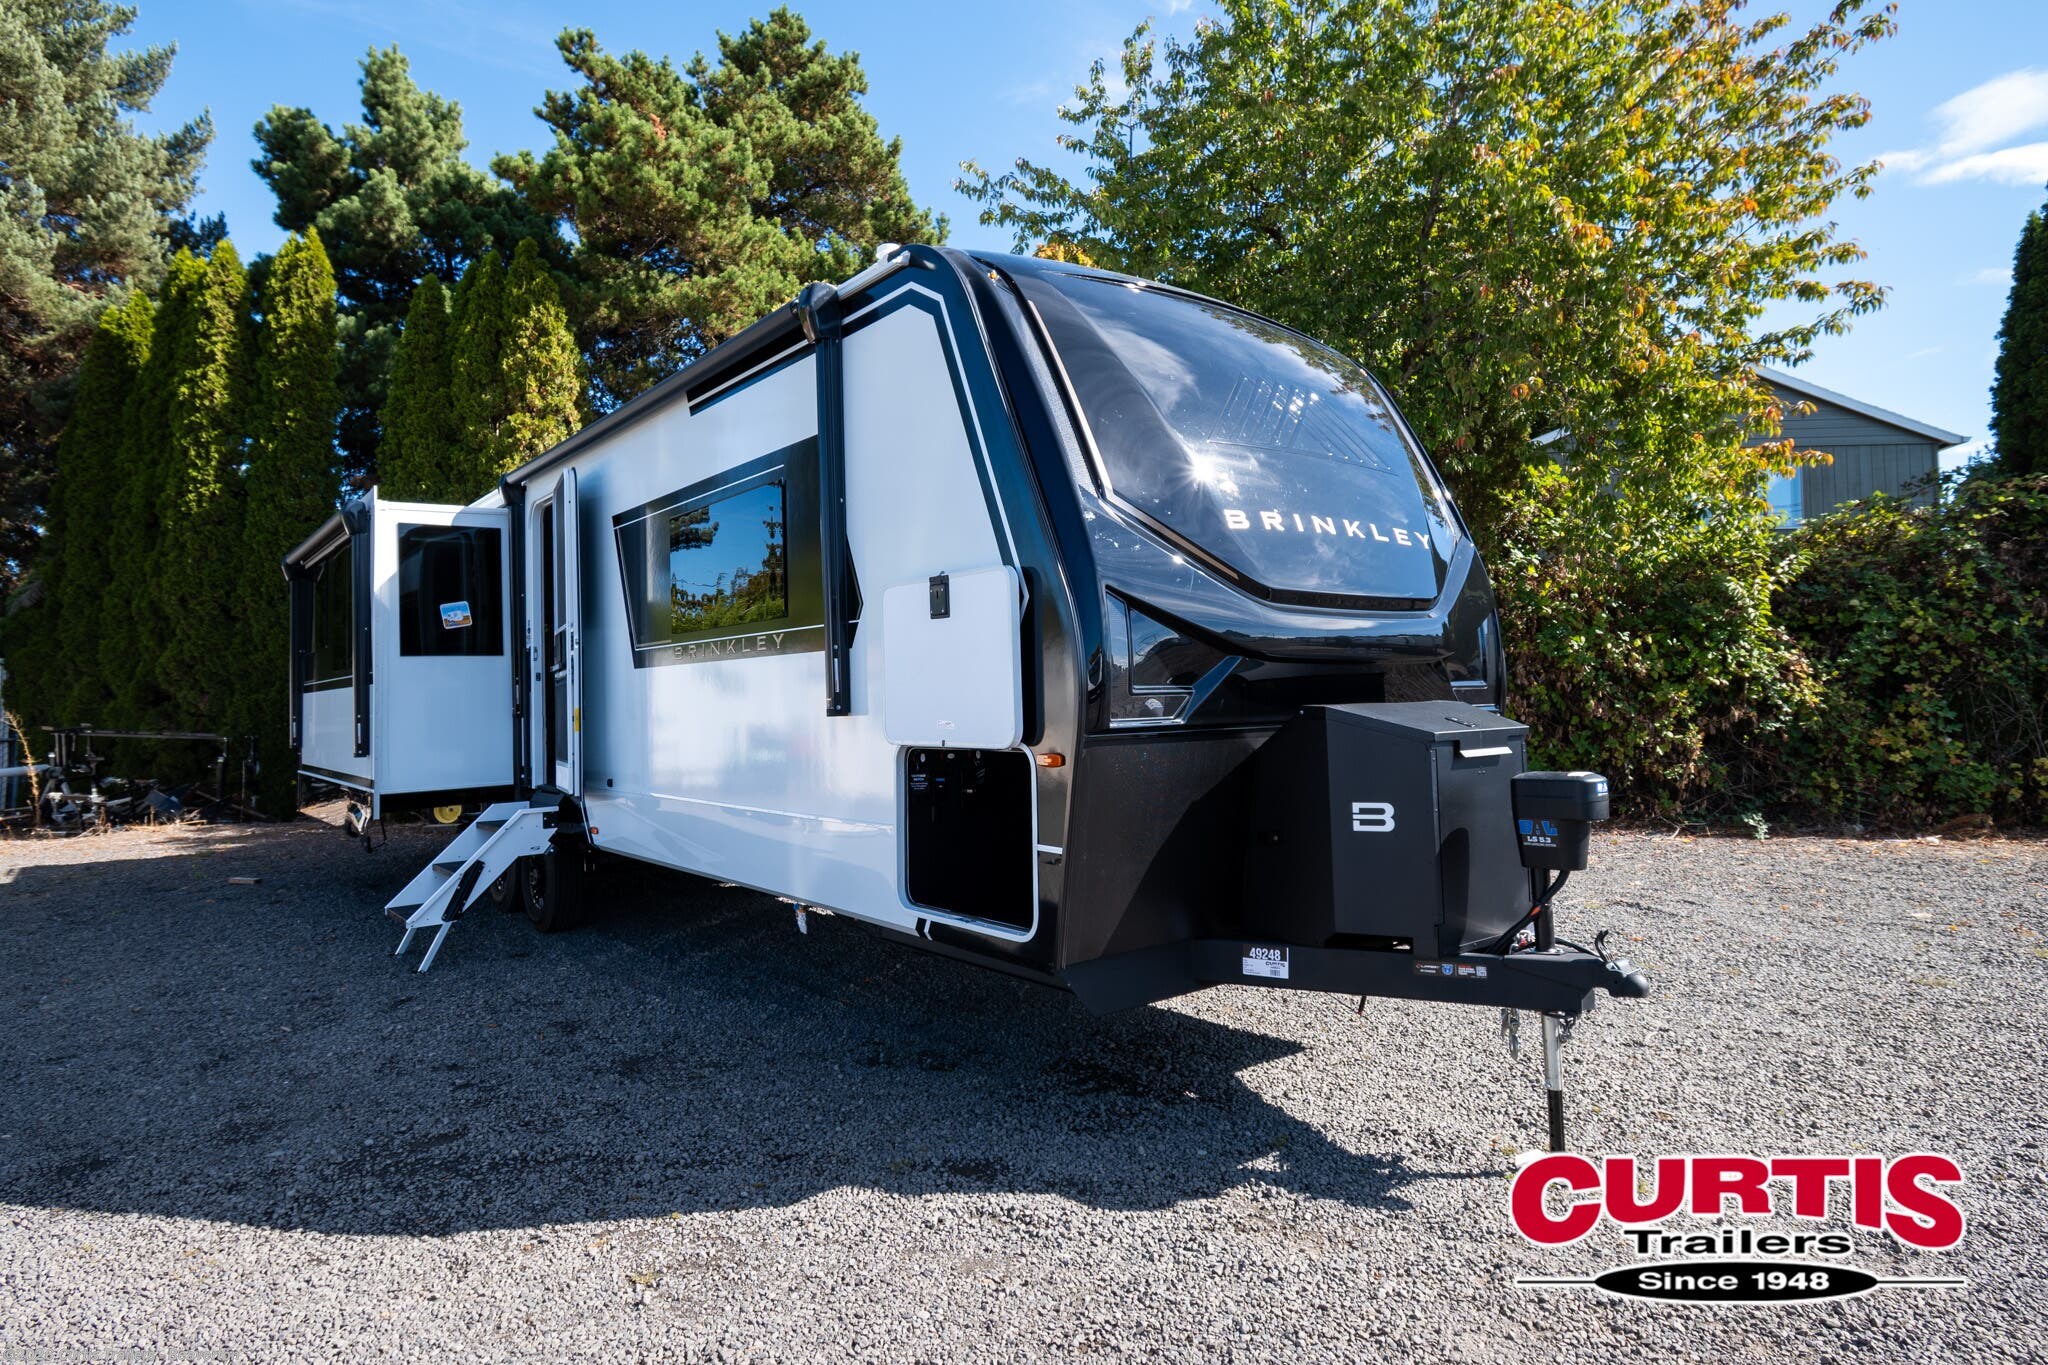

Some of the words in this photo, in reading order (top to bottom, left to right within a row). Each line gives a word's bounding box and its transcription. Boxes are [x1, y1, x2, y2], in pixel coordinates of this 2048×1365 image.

[1223, 509, 1430, 549] BRINKLEY
[674, 633, 785, 660] BRINKLEY
[1351, 802, 1396, 832] B
[1249, 947, 1281, 961] 49248
